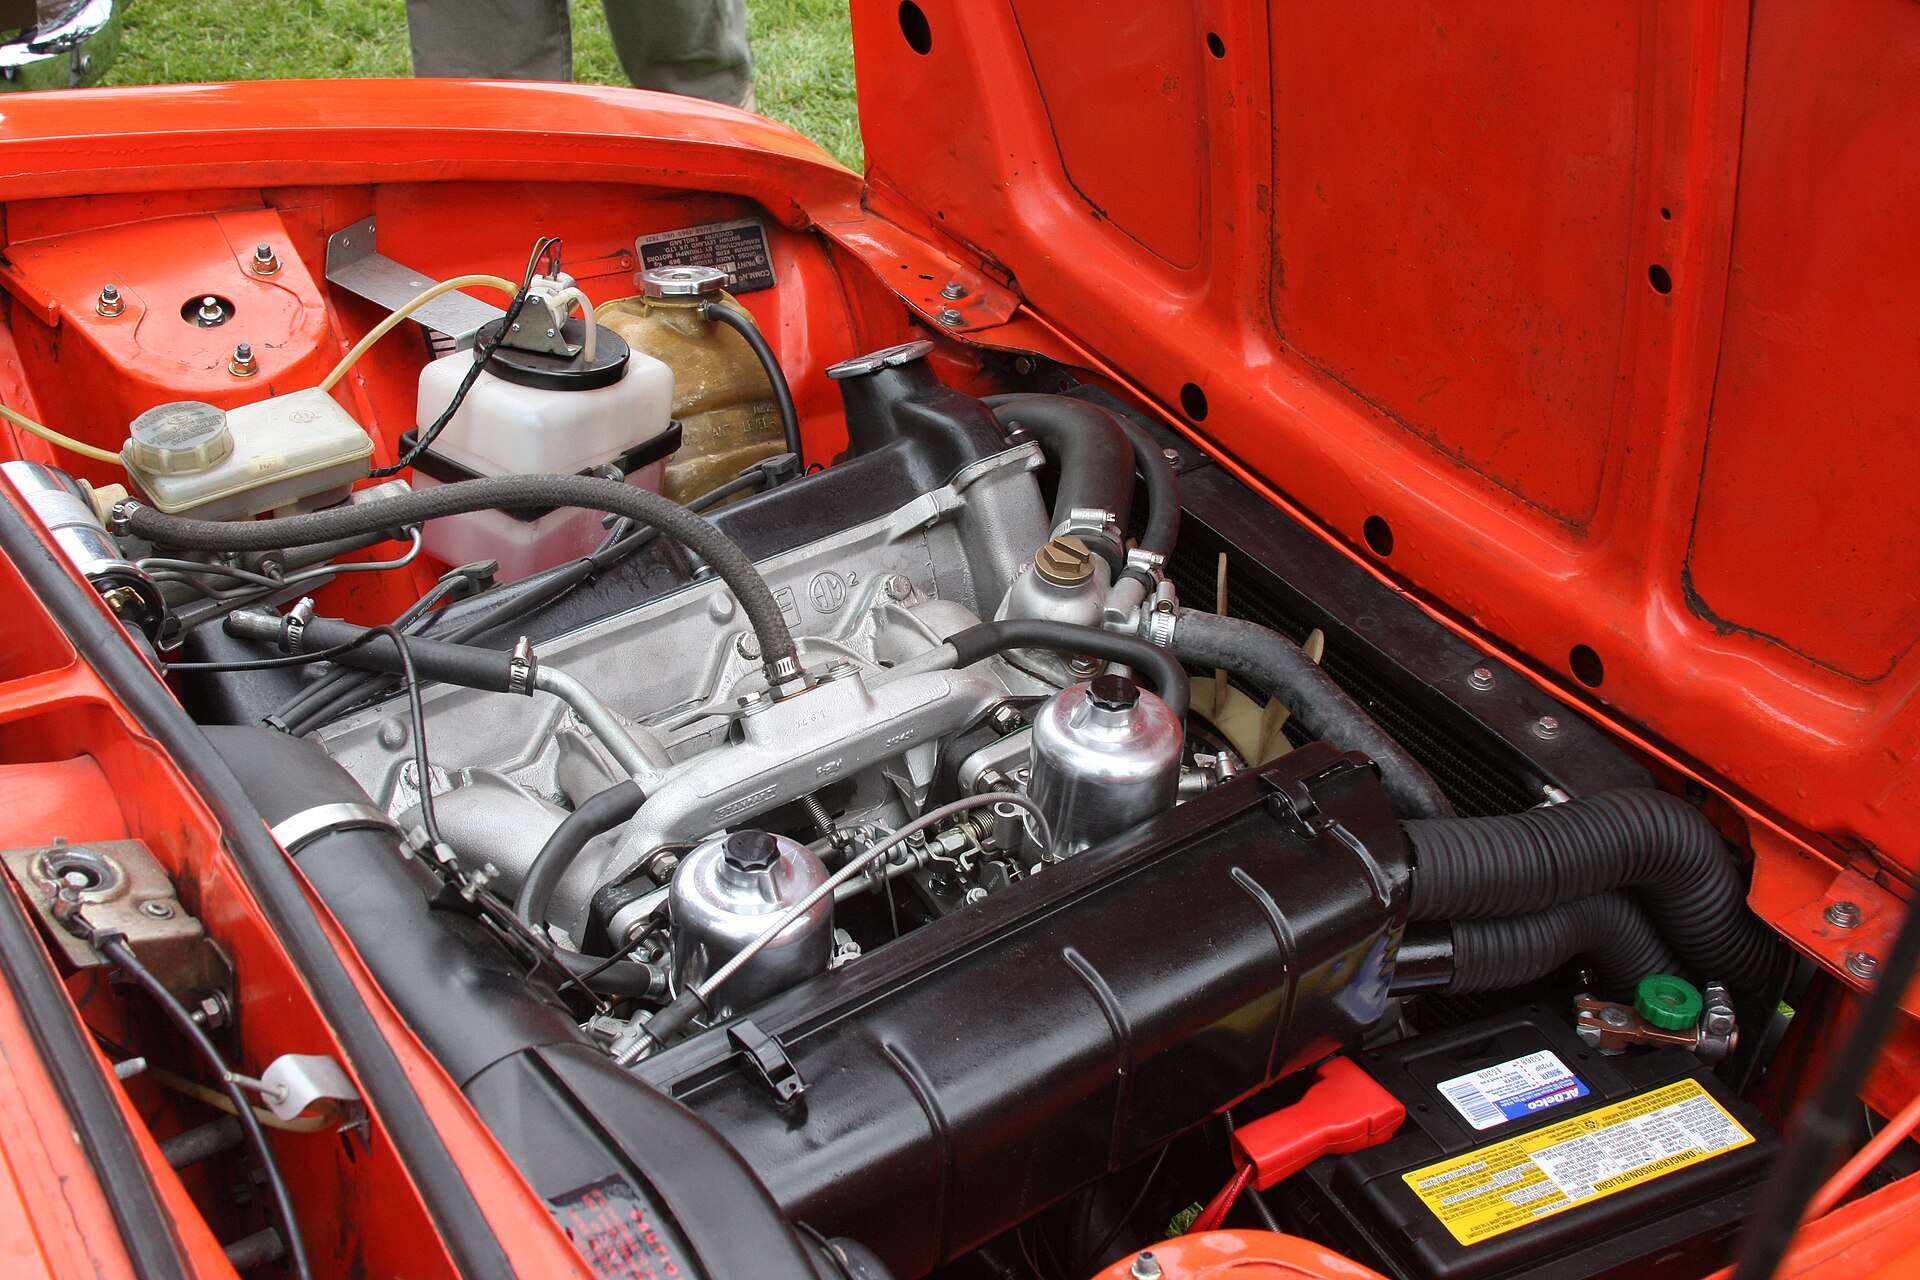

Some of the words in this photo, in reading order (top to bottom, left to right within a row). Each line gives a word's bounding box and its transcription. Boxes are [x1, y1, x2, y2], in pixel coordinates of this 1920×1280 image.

[704, 231, 734, 239] COVENTRY
[669, 237, 698, 246] ENGLAND
[692, 239, 717, 248] LEYLAND
[715, 239, 760, 250] MANUFACTURED
[647, 253, 673, 262] MOTORS
[675, 249, 703, 257] TRIUMPH
[689, 253, 713, 261] WEIGHT
[1528, 1088, 1579, 1109] ACDelco
